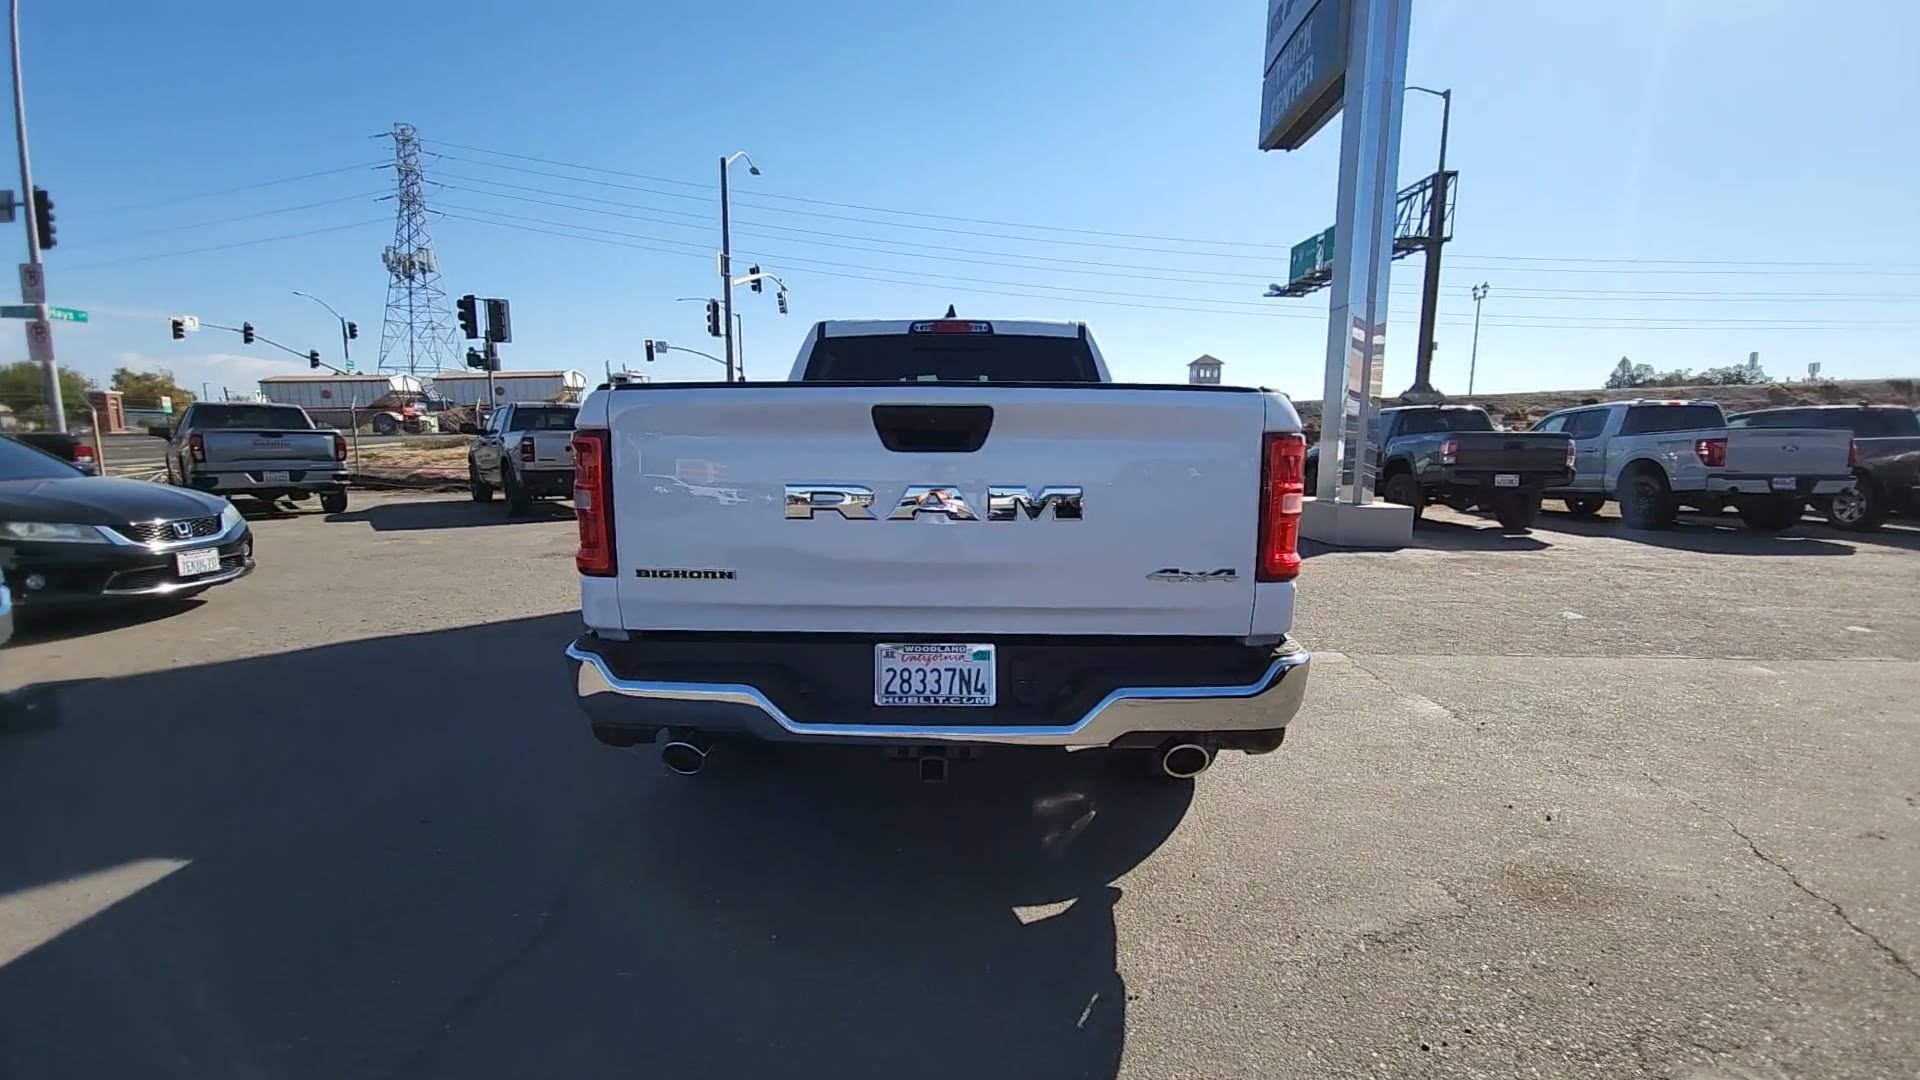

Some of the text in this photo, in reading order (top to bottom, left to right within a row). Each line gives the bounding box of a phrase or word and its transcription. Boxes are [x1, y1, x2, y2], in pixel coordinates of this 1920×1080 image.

[1275, 18, 1313, 87] TRUCK
[1271, 54, 1314, 126] CENTER
[784, 483, 1084, 521] RAM
[635, 568, 737, 580] BIGHORN
[901, 653, 974, 666] California
[904, 645, 967, 653] WOODLAND
[884, 667, 987, 696] 28337N4
[882, 696, 990, 705] HUBLIT.COM
